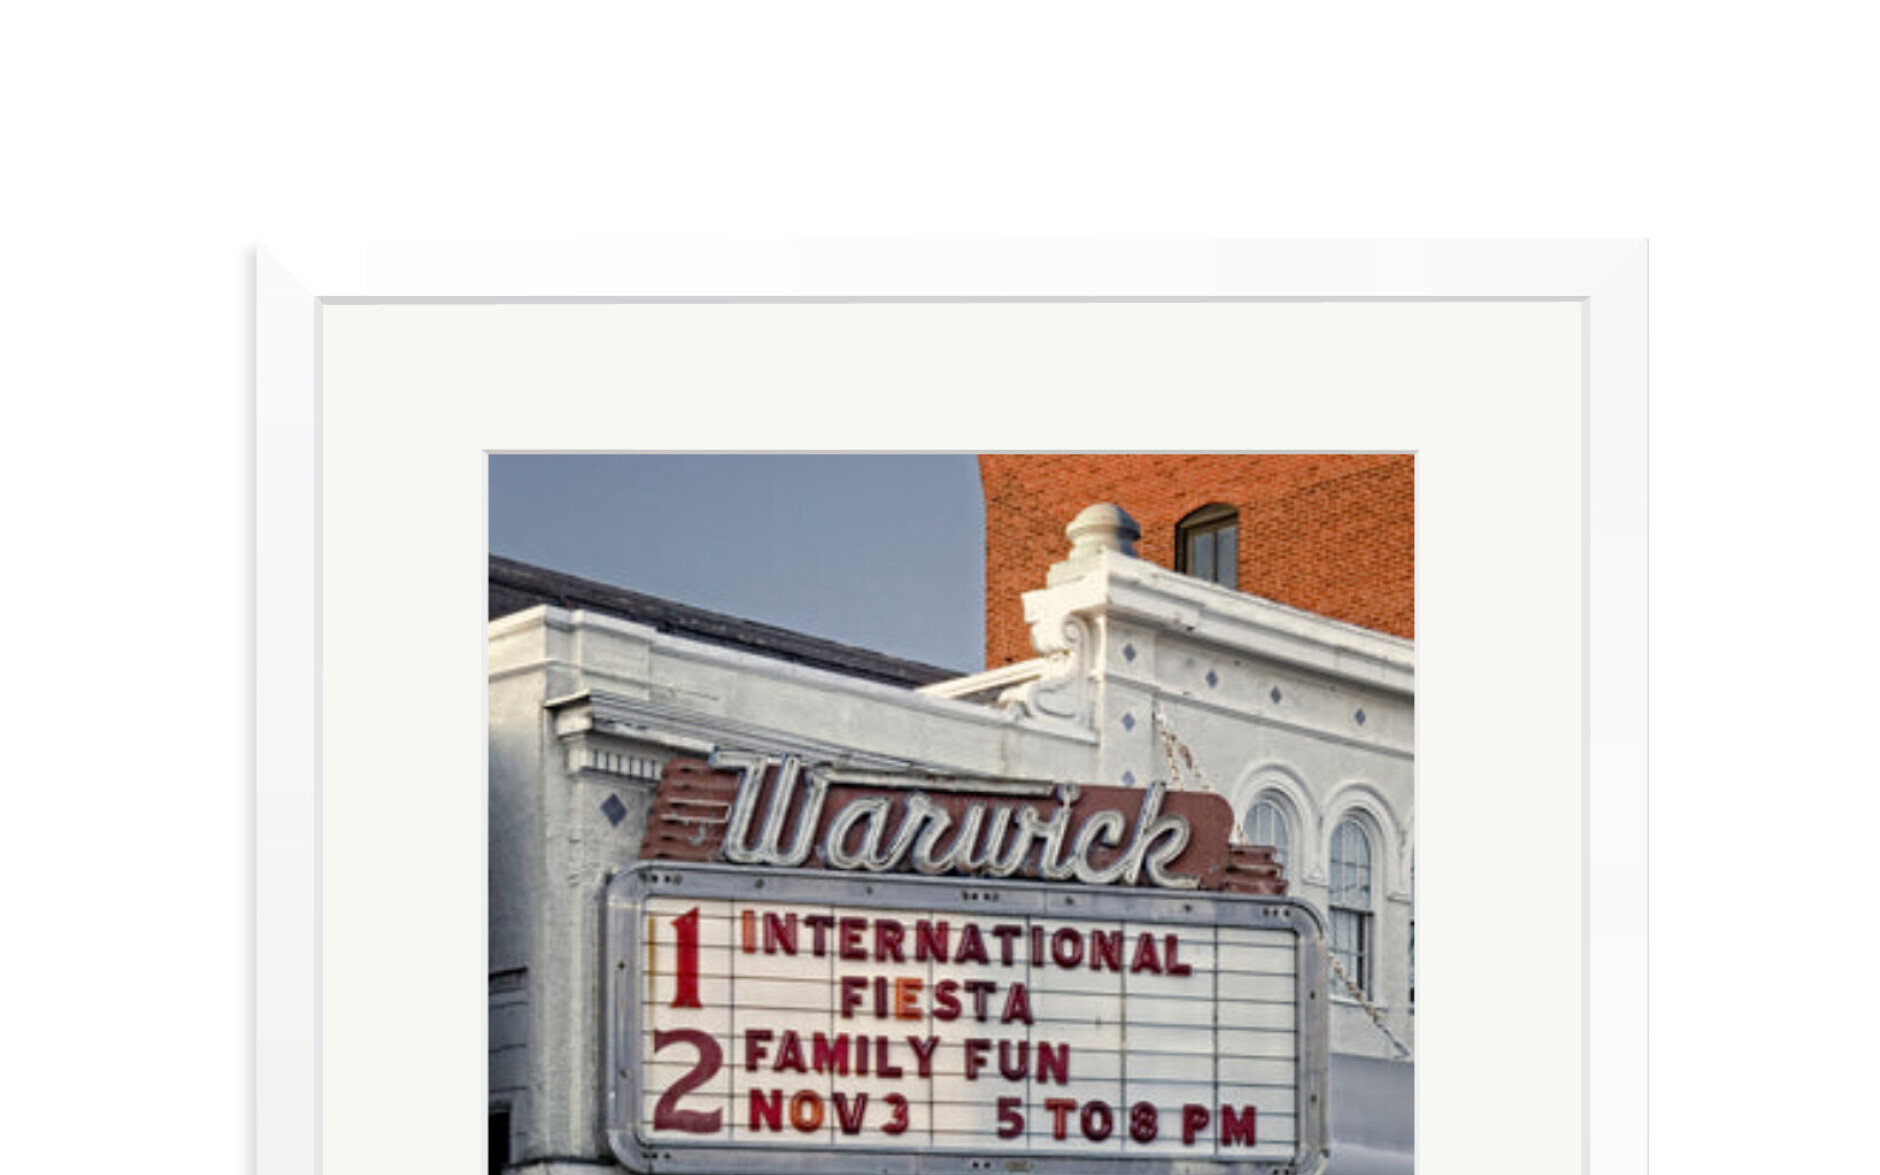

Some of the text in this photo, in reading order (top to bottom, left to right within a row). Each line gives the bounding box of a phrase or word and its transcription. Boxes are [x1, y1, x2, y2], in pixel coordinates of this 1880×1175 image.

[711, 745, 1199, 889] Warwick
[669, 906, 703, 1010] 1
[741, 909, 1192, 977] INTERNATIONAL
[841, 975, 1034, 1025] FIESTA
[653, 1027, 724, 1134] 2
[745, 1029, 1070, 1085] FAMILY FUN
[749, 1087, 1257, 1147] NOV 3 5 TO 8 PM
